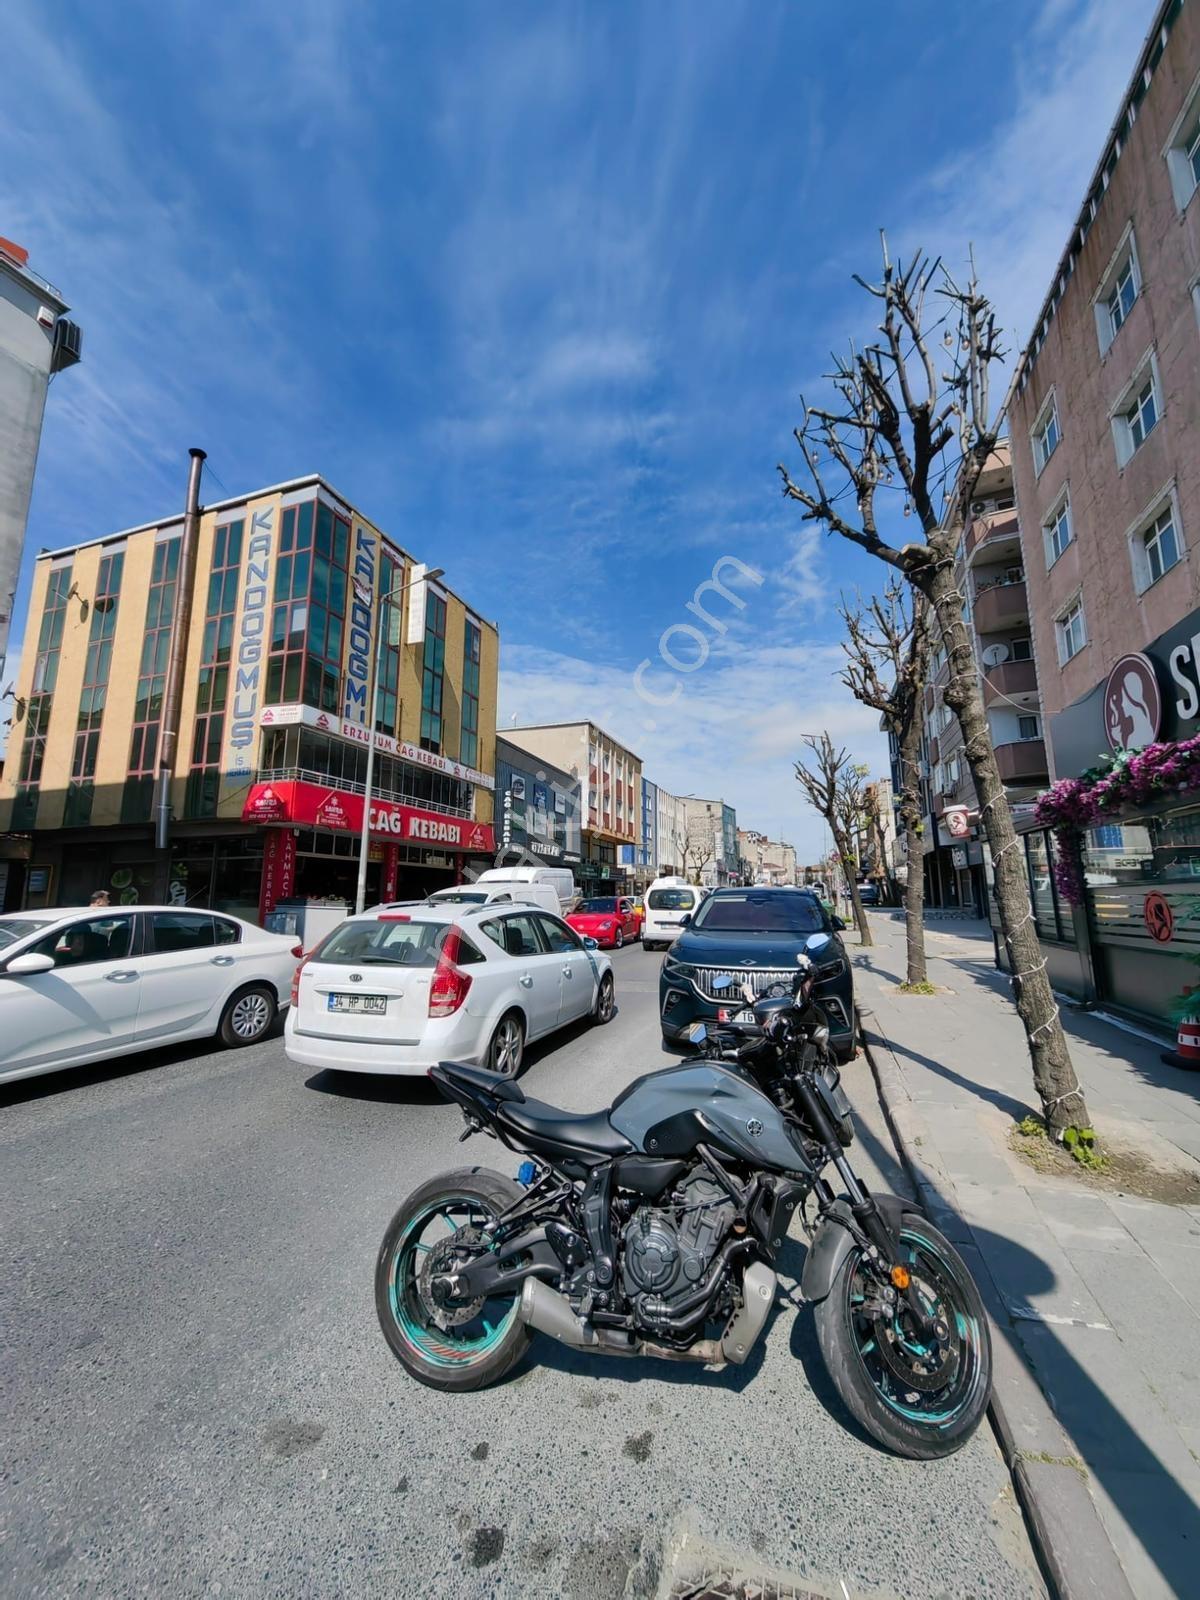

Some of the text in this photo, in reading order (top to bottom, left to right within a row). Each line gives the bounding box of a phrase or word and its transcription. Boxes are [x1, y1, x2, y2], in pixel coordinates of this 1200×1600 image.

[344, 528, 376, 723] KADOĞM
[343, 724, 392, 750] ERZUUM
[409, 817, 461, 844] KEBABI
